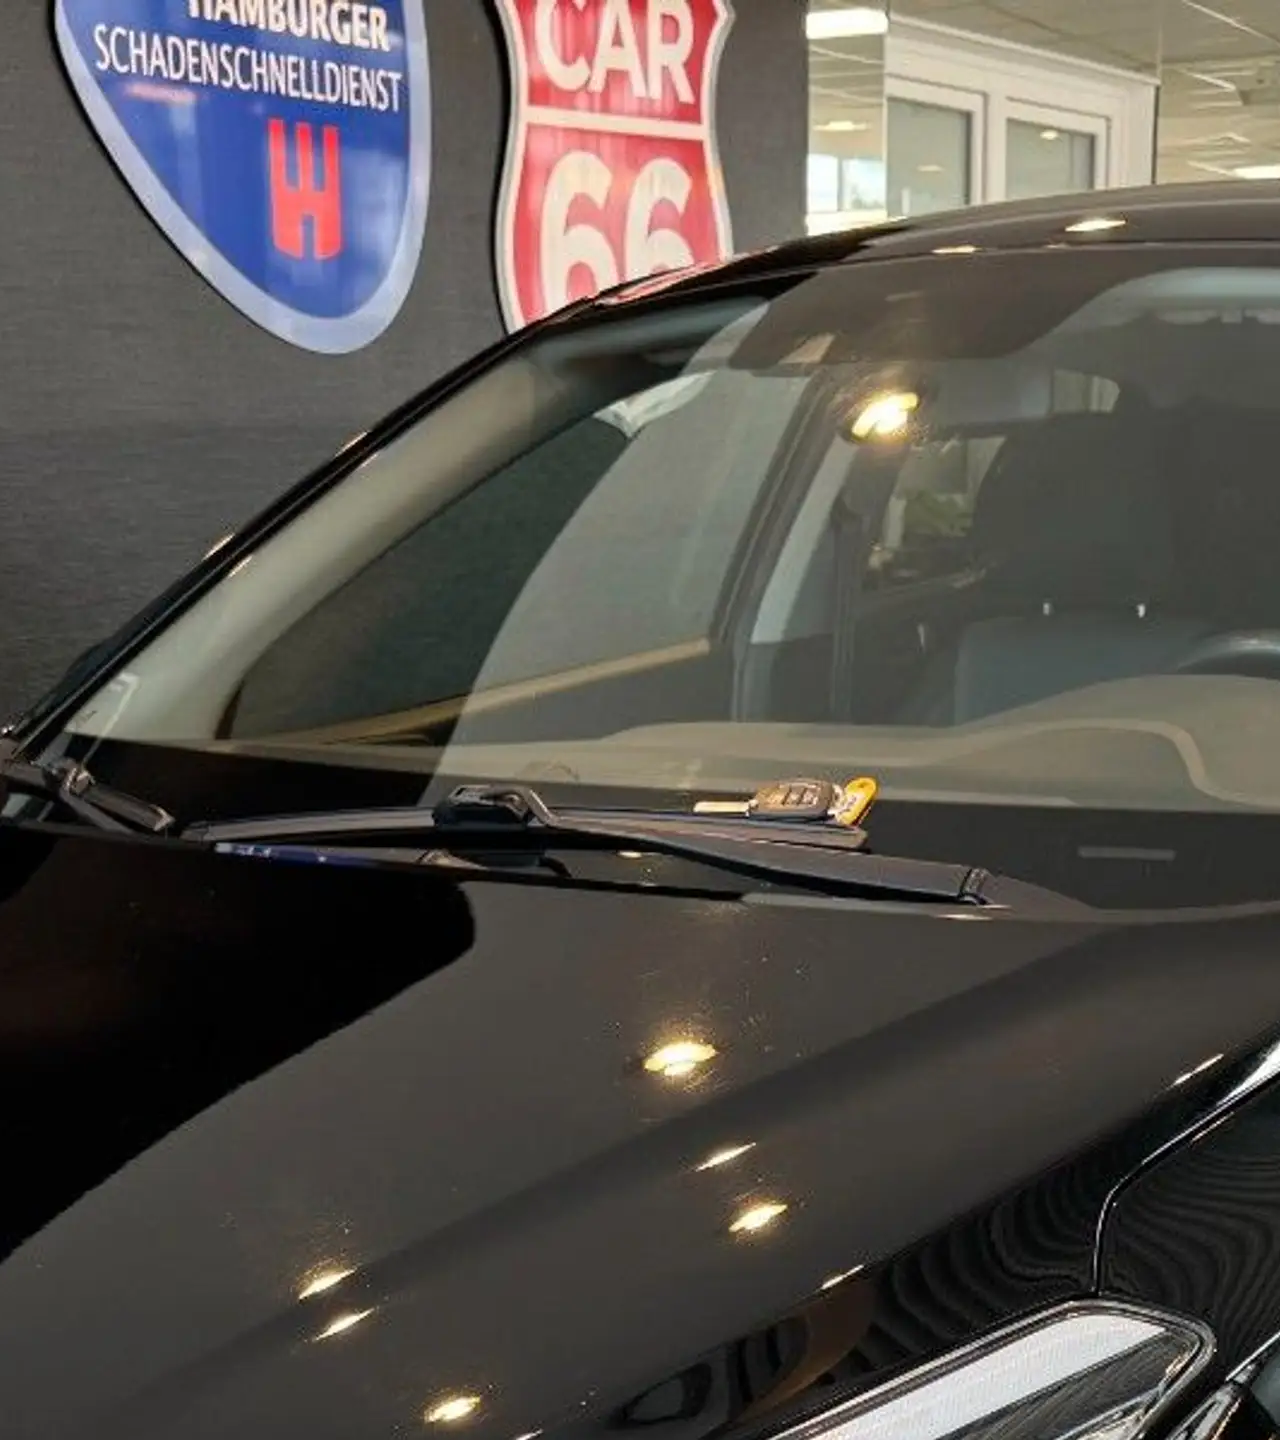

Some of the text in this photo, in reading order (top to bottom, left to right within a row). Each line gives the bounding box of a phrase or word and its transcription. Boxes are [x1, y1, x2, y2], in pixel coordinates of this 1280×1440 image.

[93, 23, 402, 111] SCHADENSCHNELLDIENST
[535, 0, 696, 104] CAR
[540, 151, 695, 314] 66
